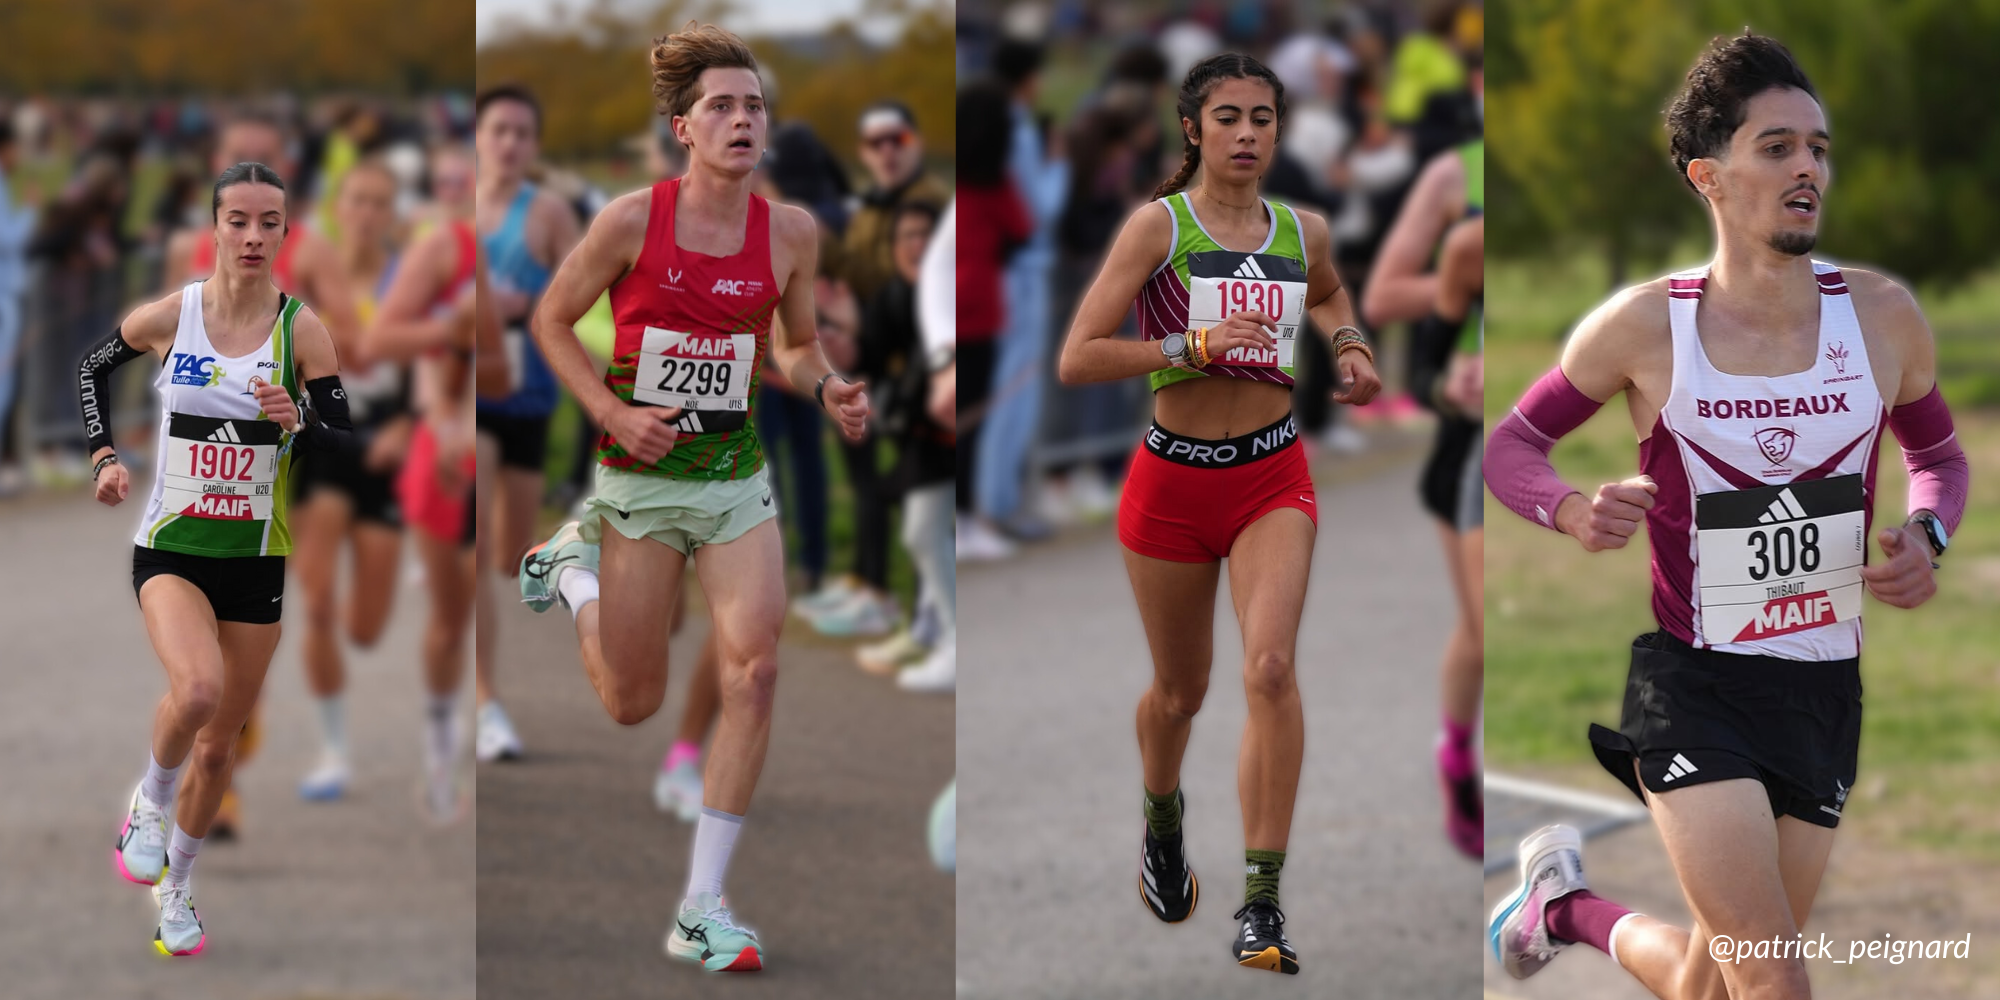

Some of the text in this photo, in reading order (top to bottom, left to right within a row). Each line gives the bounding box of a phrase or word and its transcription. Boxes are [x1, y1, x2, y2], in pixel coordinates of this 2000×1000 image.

[1217, 281, 1284, 322] 1930
[1282, 326, 1295, 338] U18
[677, 338, 733, 357] MAIF
[172, 353, 216, 377] TAC
[657, 359, 732, 396] 2299
[685, 399, 743, 409] NOE U18
[1696, 392, 1851, 419] BORDEAUX
[1166, 440, 1238, 463] PRO
[1252, 416, 1297, 456] NIKE
[189, 443, 255, 481] 1902
[202, 483, 270, 495] CAROLINE U20
[194, 498, 251, 517] MAIF
[1747, 522, 1820, 581] 308
[1766, 581, 1806, 599] THIBAUT
[1753, 595, 1833, 634] MAIF
